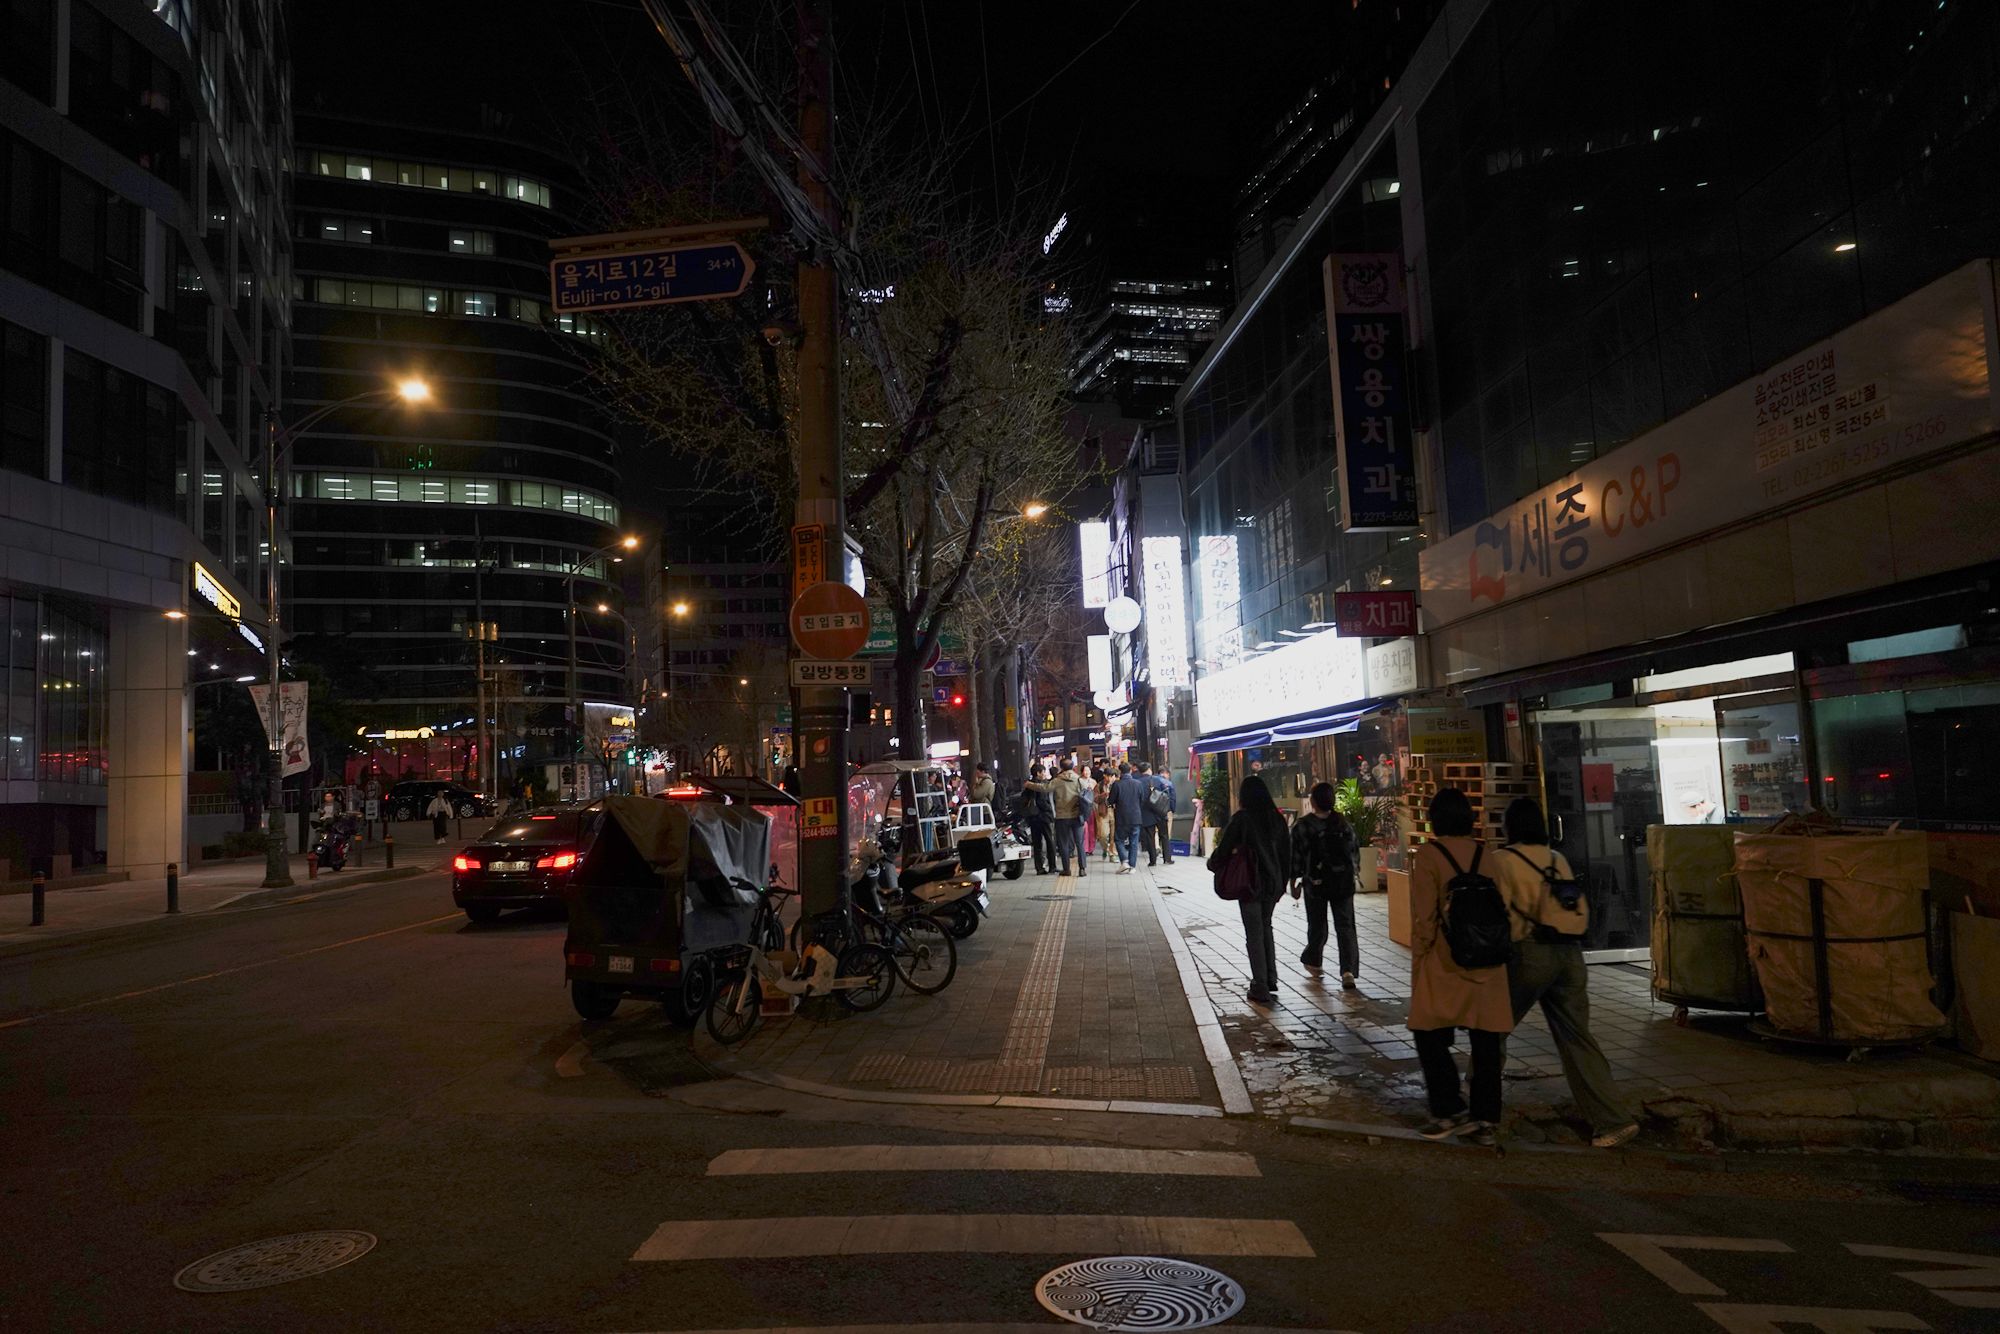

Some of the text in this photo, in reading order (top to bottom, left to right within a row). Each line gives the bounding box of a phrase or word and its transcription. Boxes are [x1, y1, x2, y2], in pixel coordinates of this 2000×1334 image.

[561, 254, 677, 288] 을지로12길
[561, 282, 671, 307] Eulji-ro 12-gil
[1754, 348, 1835, 405] 옵셋전문인쇄
[1347, 322, 1400, 502] 쌍용치과
[1756, 373, 1837, 427] 소량인쇄전문
[1758, 421, 1789, 448] 고모리
[1835, 383, 1877, 412] 국반절
[1759, 444, 1790, 470] 고모리
[1835, 404, 1887, 435] 국전5색
[1794, 437, 1890, 488] 02-2267-5255
[1904, 414, 1946, 457] 5266
[1363, 511, 1416, 522] 2273-5654
[1519, 452, 1681, 578] 세종 C&P
[804, 614, 860, 630] 진입금지
[1365, 600, 1411, 629] 치과
[800, 665, 867, 681] 일방통행
[1372, 648, 1413, 681] 쌍용치과
[1425, 718, 1472, 731] 열린애드
